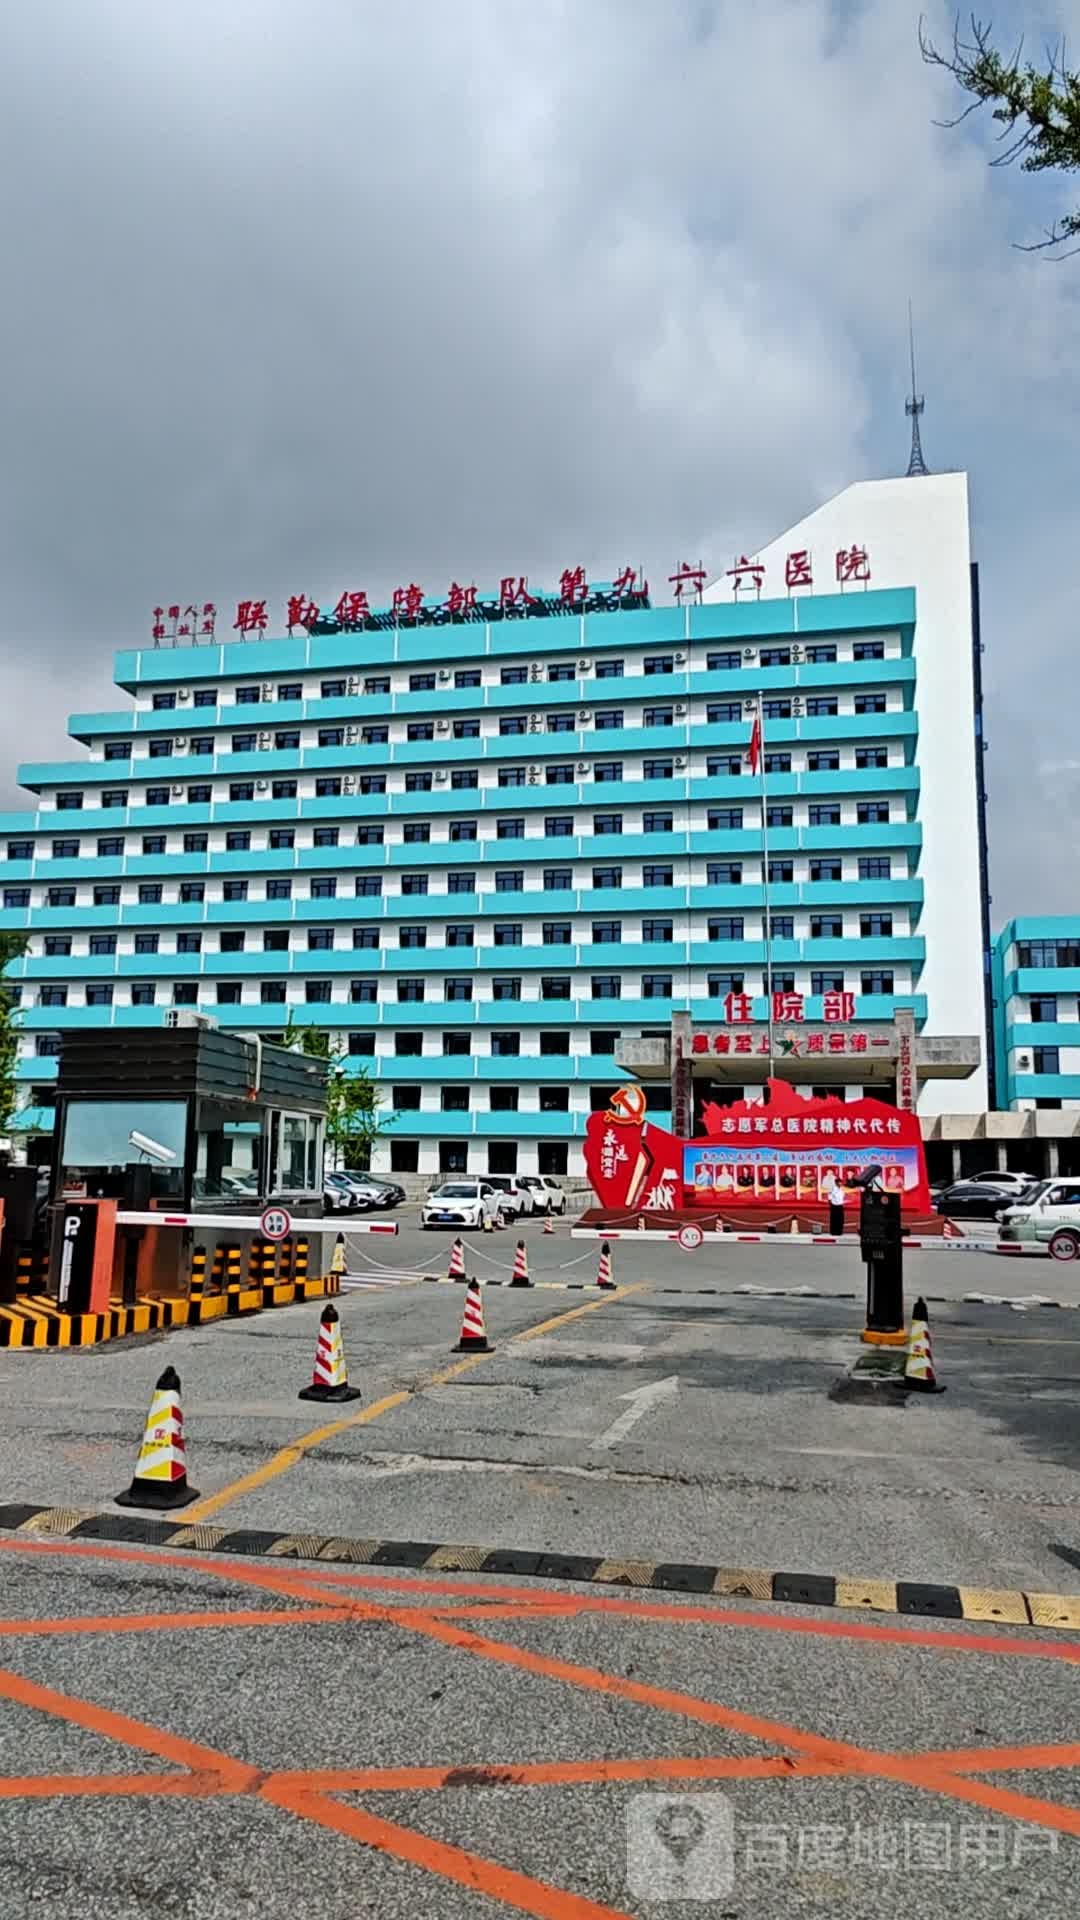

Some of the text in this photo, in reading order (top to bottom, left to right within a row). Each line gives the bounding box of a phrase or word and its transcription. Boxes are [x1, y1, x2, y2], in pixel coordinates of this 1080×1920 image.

[723, 989, 856, 1024] 住院部
[691, 1033, 890, 1054] 患者至上 质量第一
[721, 1117, 901, 1134] 志愿军总医院精神代代传
